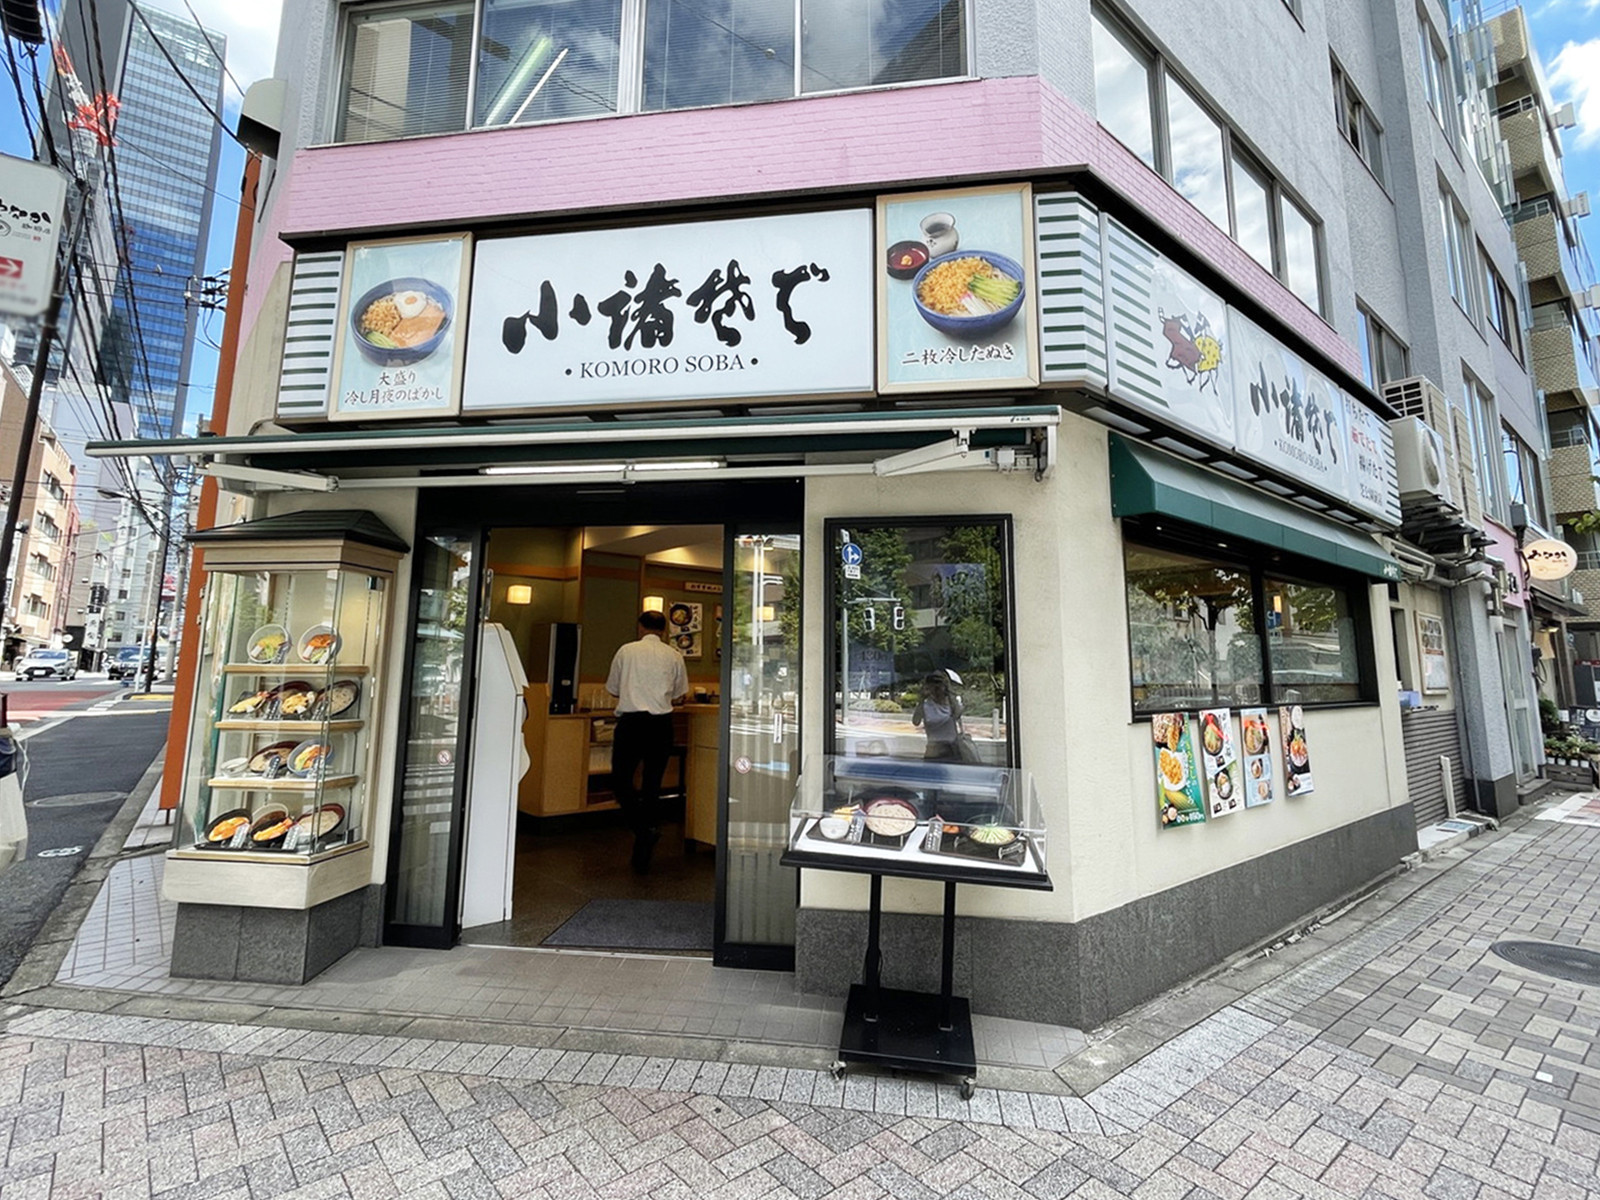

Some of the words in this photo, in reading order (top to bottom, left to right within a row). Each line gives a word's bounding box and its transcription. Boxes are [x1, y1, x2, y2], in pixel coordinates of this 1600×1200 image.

[902, 344, 1014, 365] 二枚冷したぬき
[580, 356, 679, 379] KOMORO
[685, 353, 745, 373] SOBA
[379, 369, 416, 386] 大盛り
[344, 386, 444, 406] 冷し月夜のばかし
